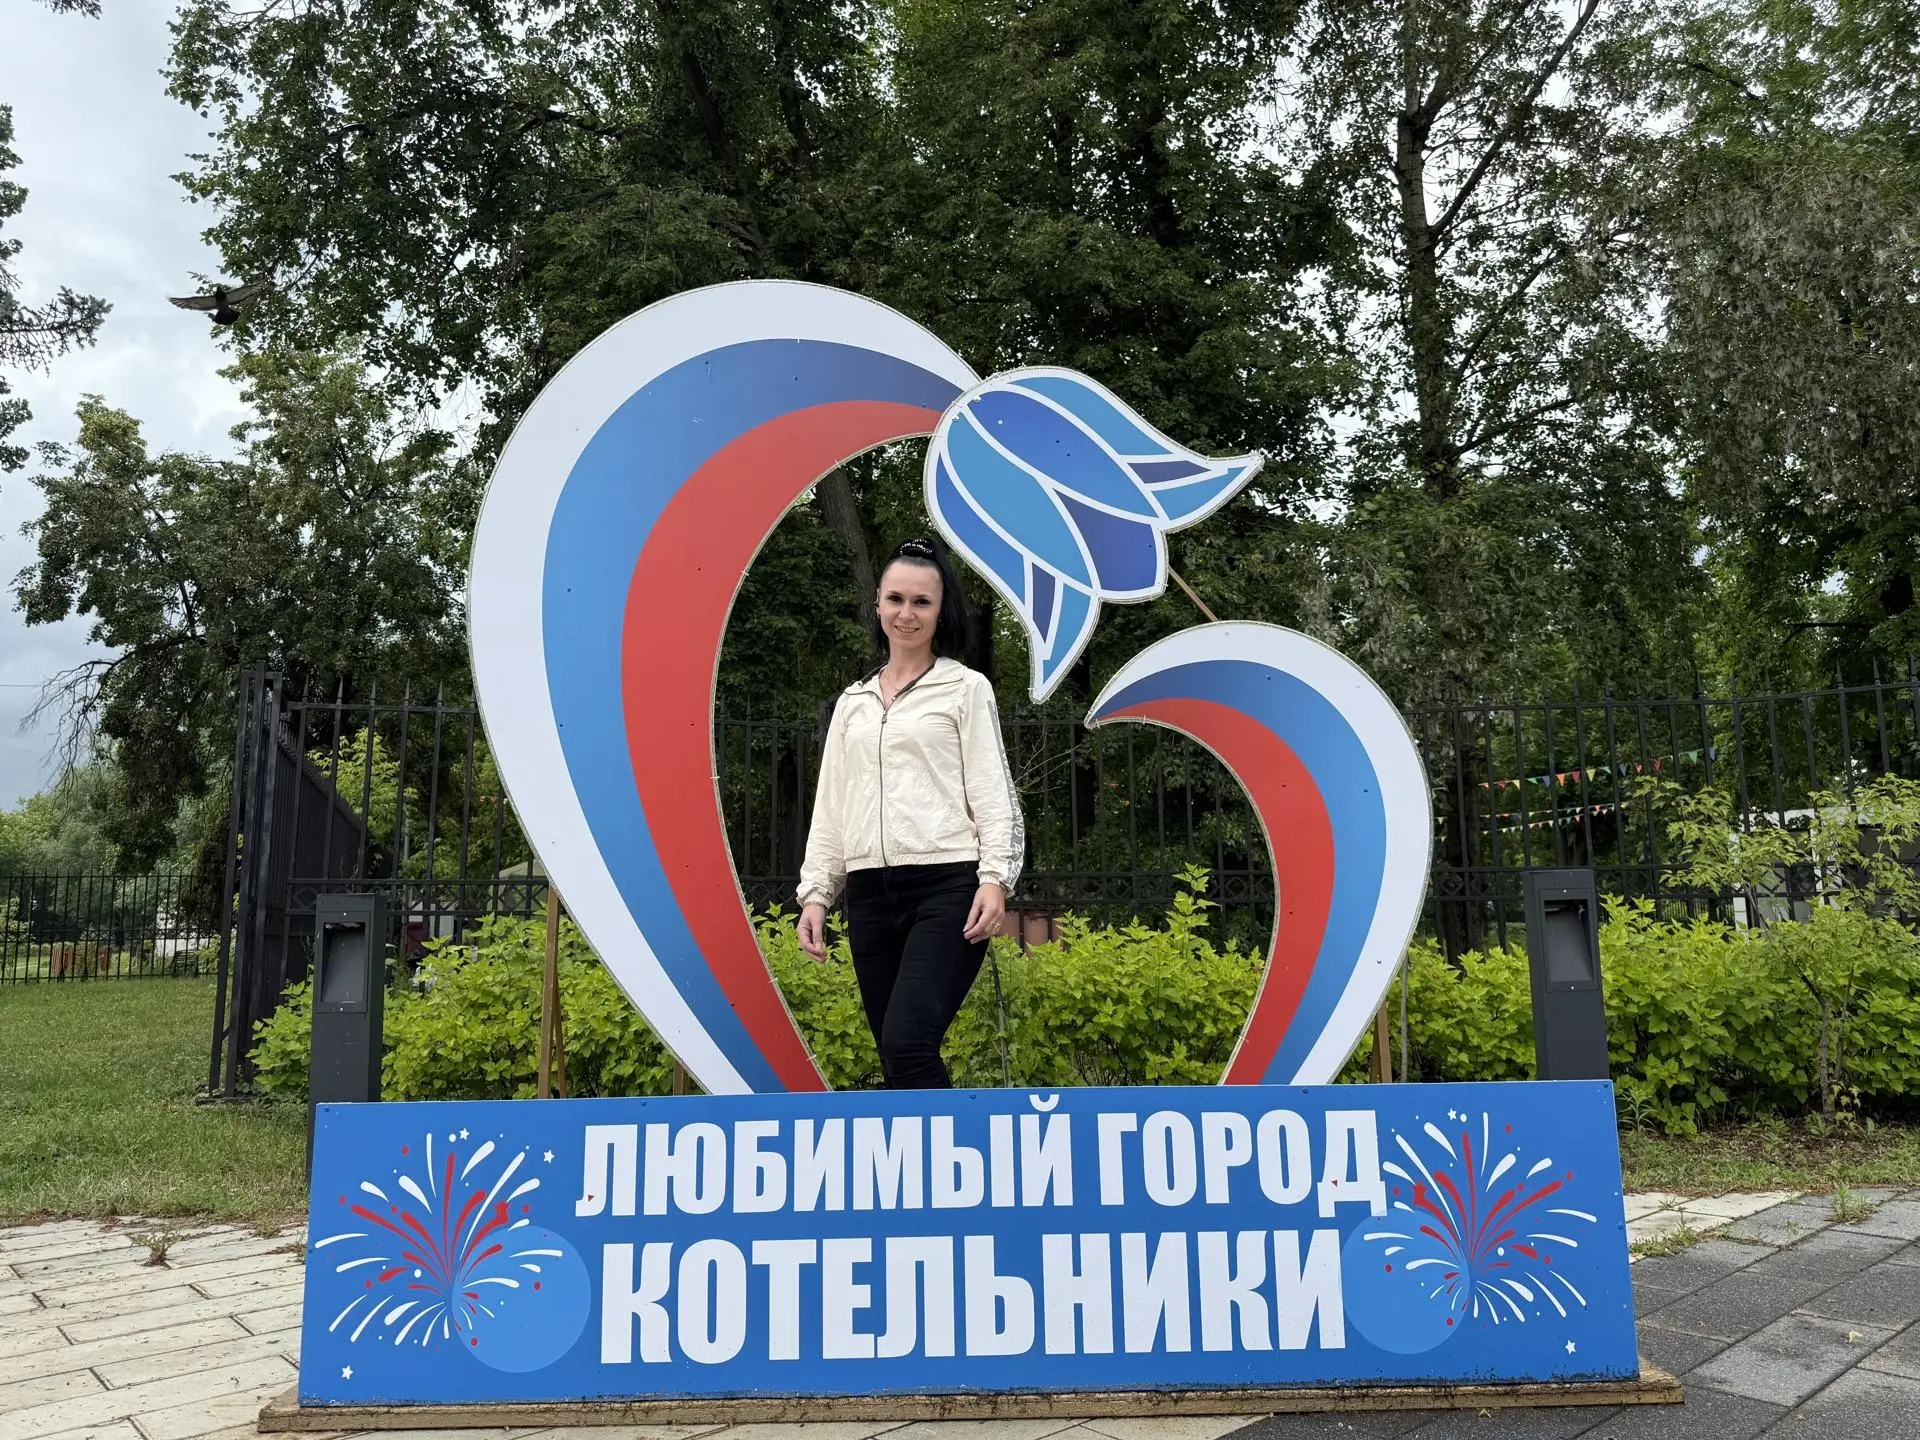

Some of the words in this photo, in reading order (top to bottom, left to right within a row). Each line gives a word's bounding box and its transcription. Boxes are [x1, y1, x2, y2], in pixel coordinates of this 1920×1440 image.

[576, 1095, 1073, 1217] ЛЮБИМЫЙ
[1098, 1110, 1387, 1218] ГОРОД
[602, 1230, 1346, 1364] КОТЕЛЬНИКИ
